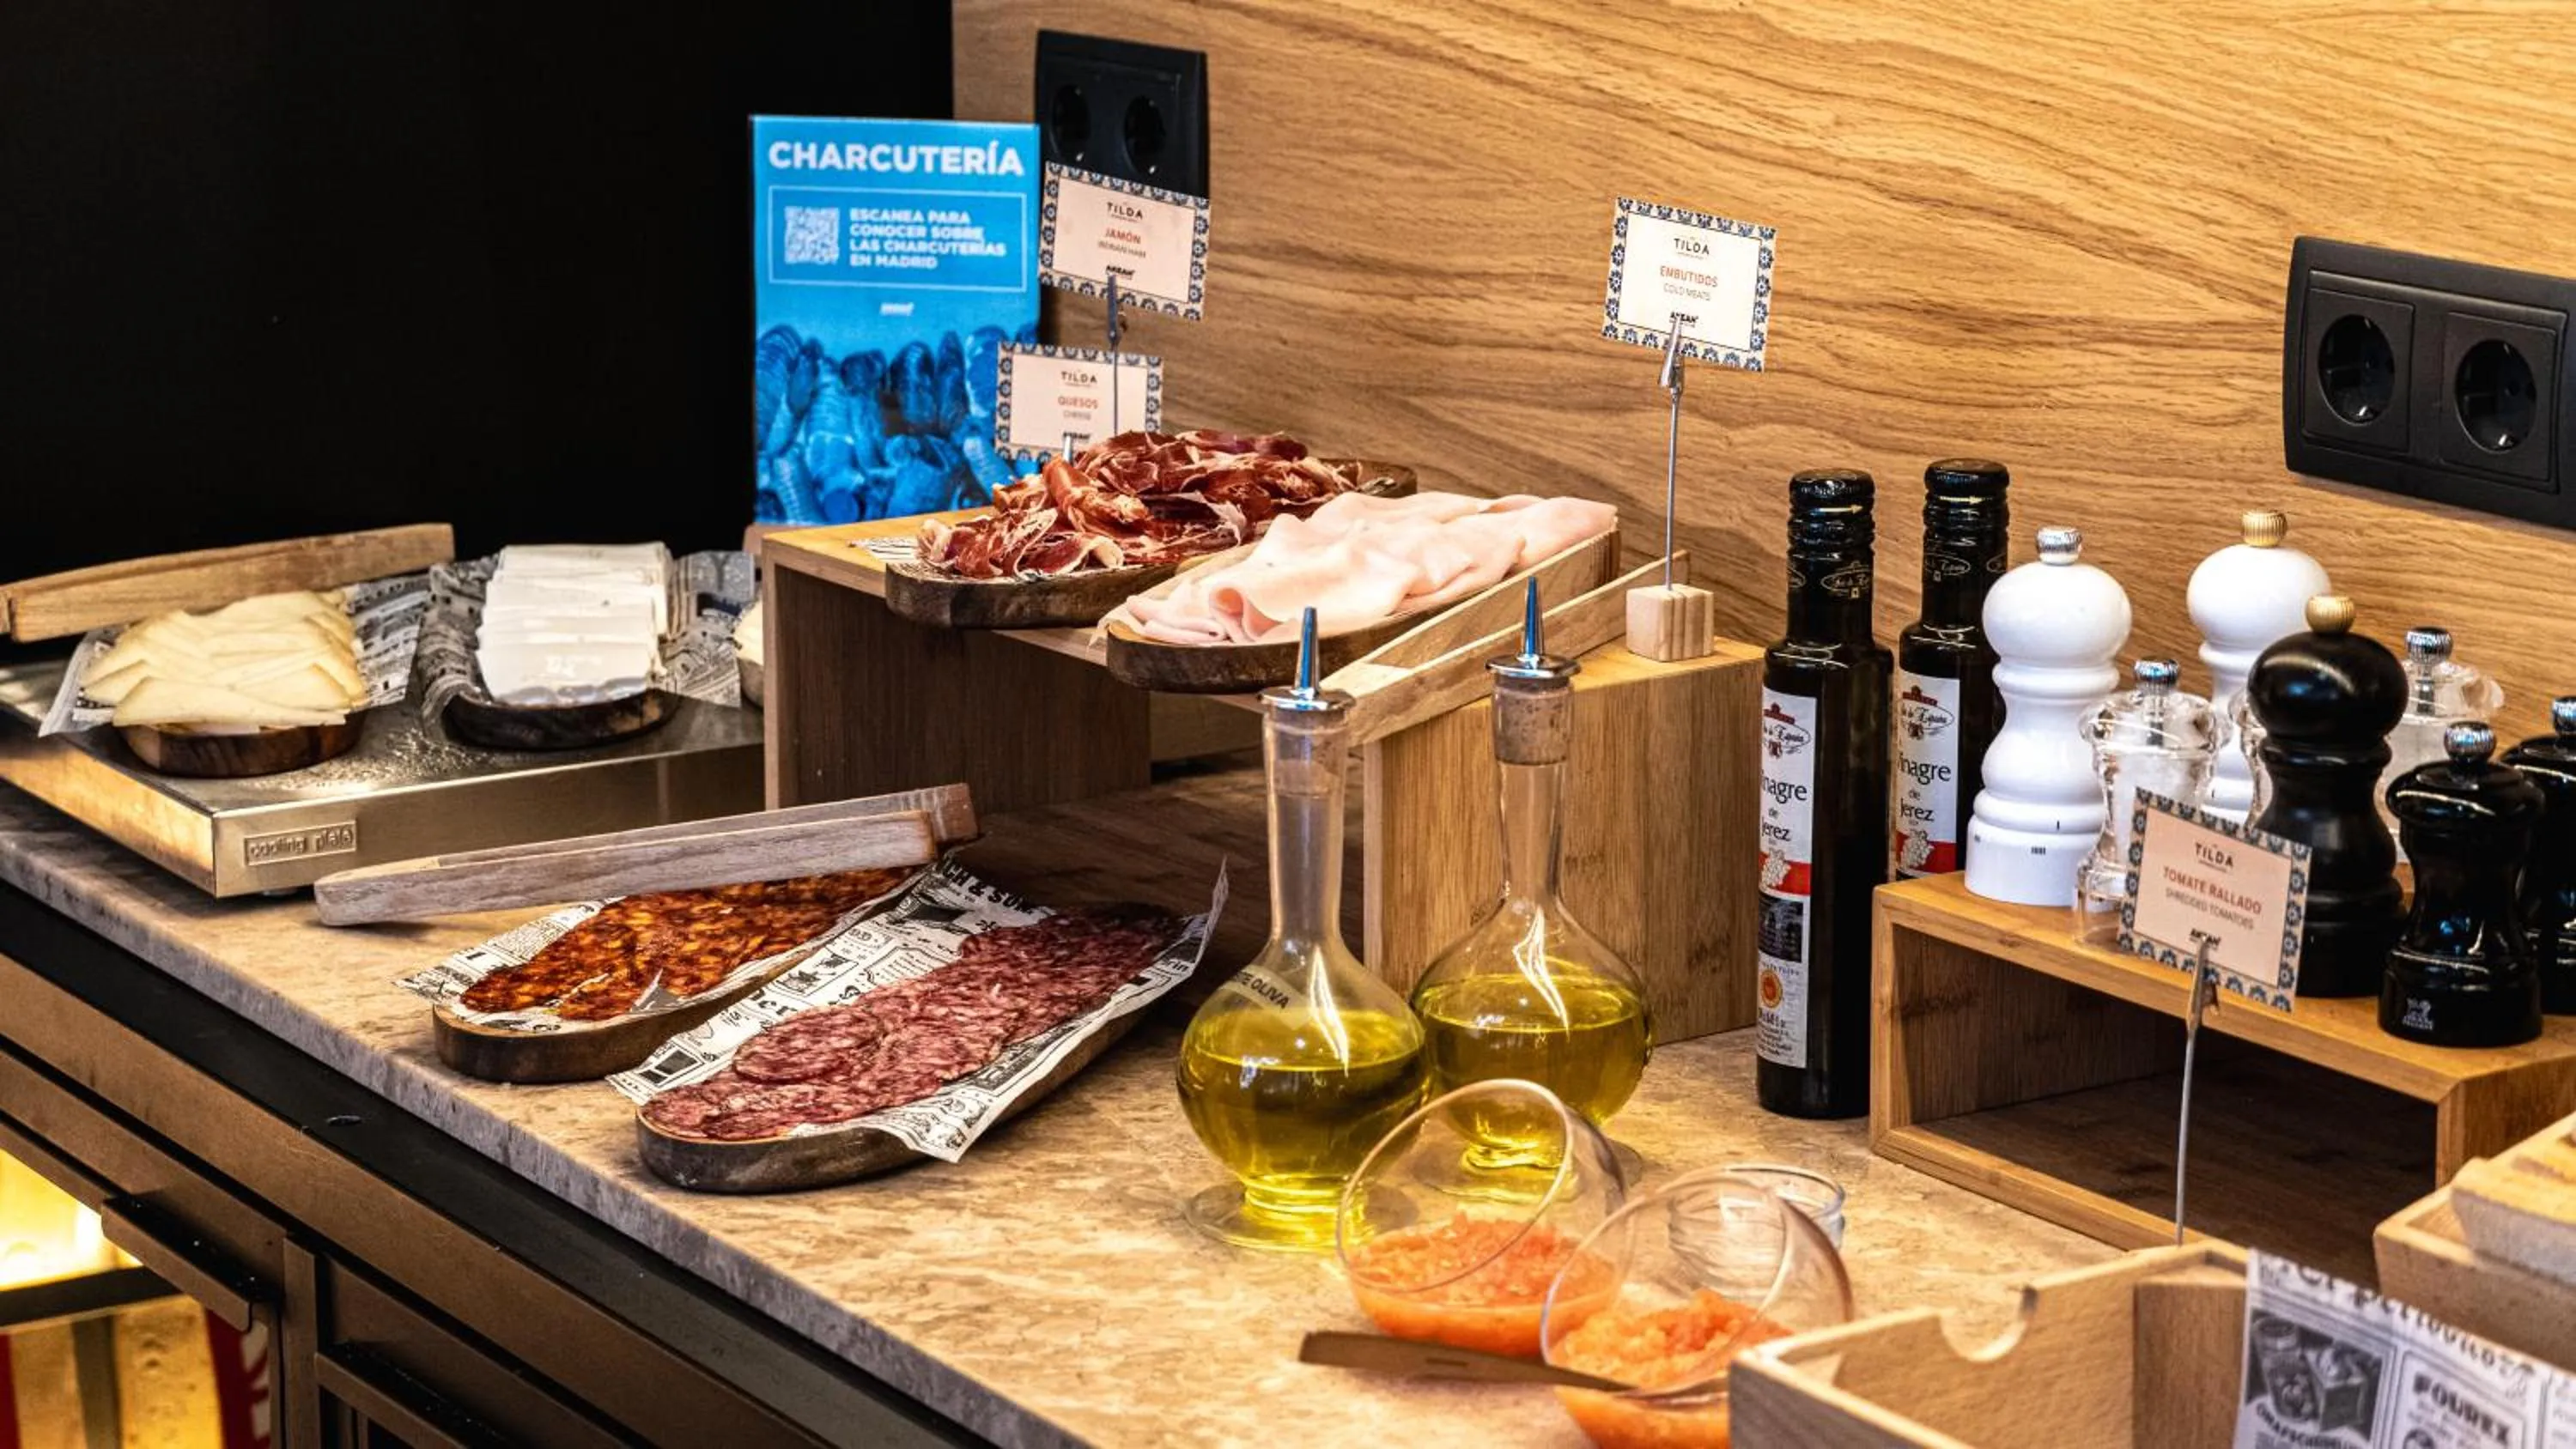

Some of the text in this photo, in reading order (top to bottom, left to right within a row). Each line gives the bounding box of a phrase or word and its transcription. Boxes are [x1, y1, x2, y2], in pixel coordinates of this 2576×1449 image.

[769, 139, 1025, 177] CHARCUTERÍA
[849, 208, 971, 224] ESCANEA PARA
[1107, 202, 1144, 220] TILDA
[849, 223, 984, 241] CONOCER SOBRE
[849, 239, 1007, 258] LAS CHARCUTERÍAS
[1674, 238, 1710, 255] TILDA
[849, 254, 939, 270] EN MADRID
[1660, 265, 1718, 288] EMBUTIDOS
[1060, 370, 1097, 385] TILDA
[1898, 752, 1952, 785] inagre
[1900, 798, 1935, 822] Jerez
[2196, 842, 2233, 867] TILDA
[2164, 865, 2262, 915] TOMATE RALLADO
[1251, 978, 1290, 1009] OLIVA
